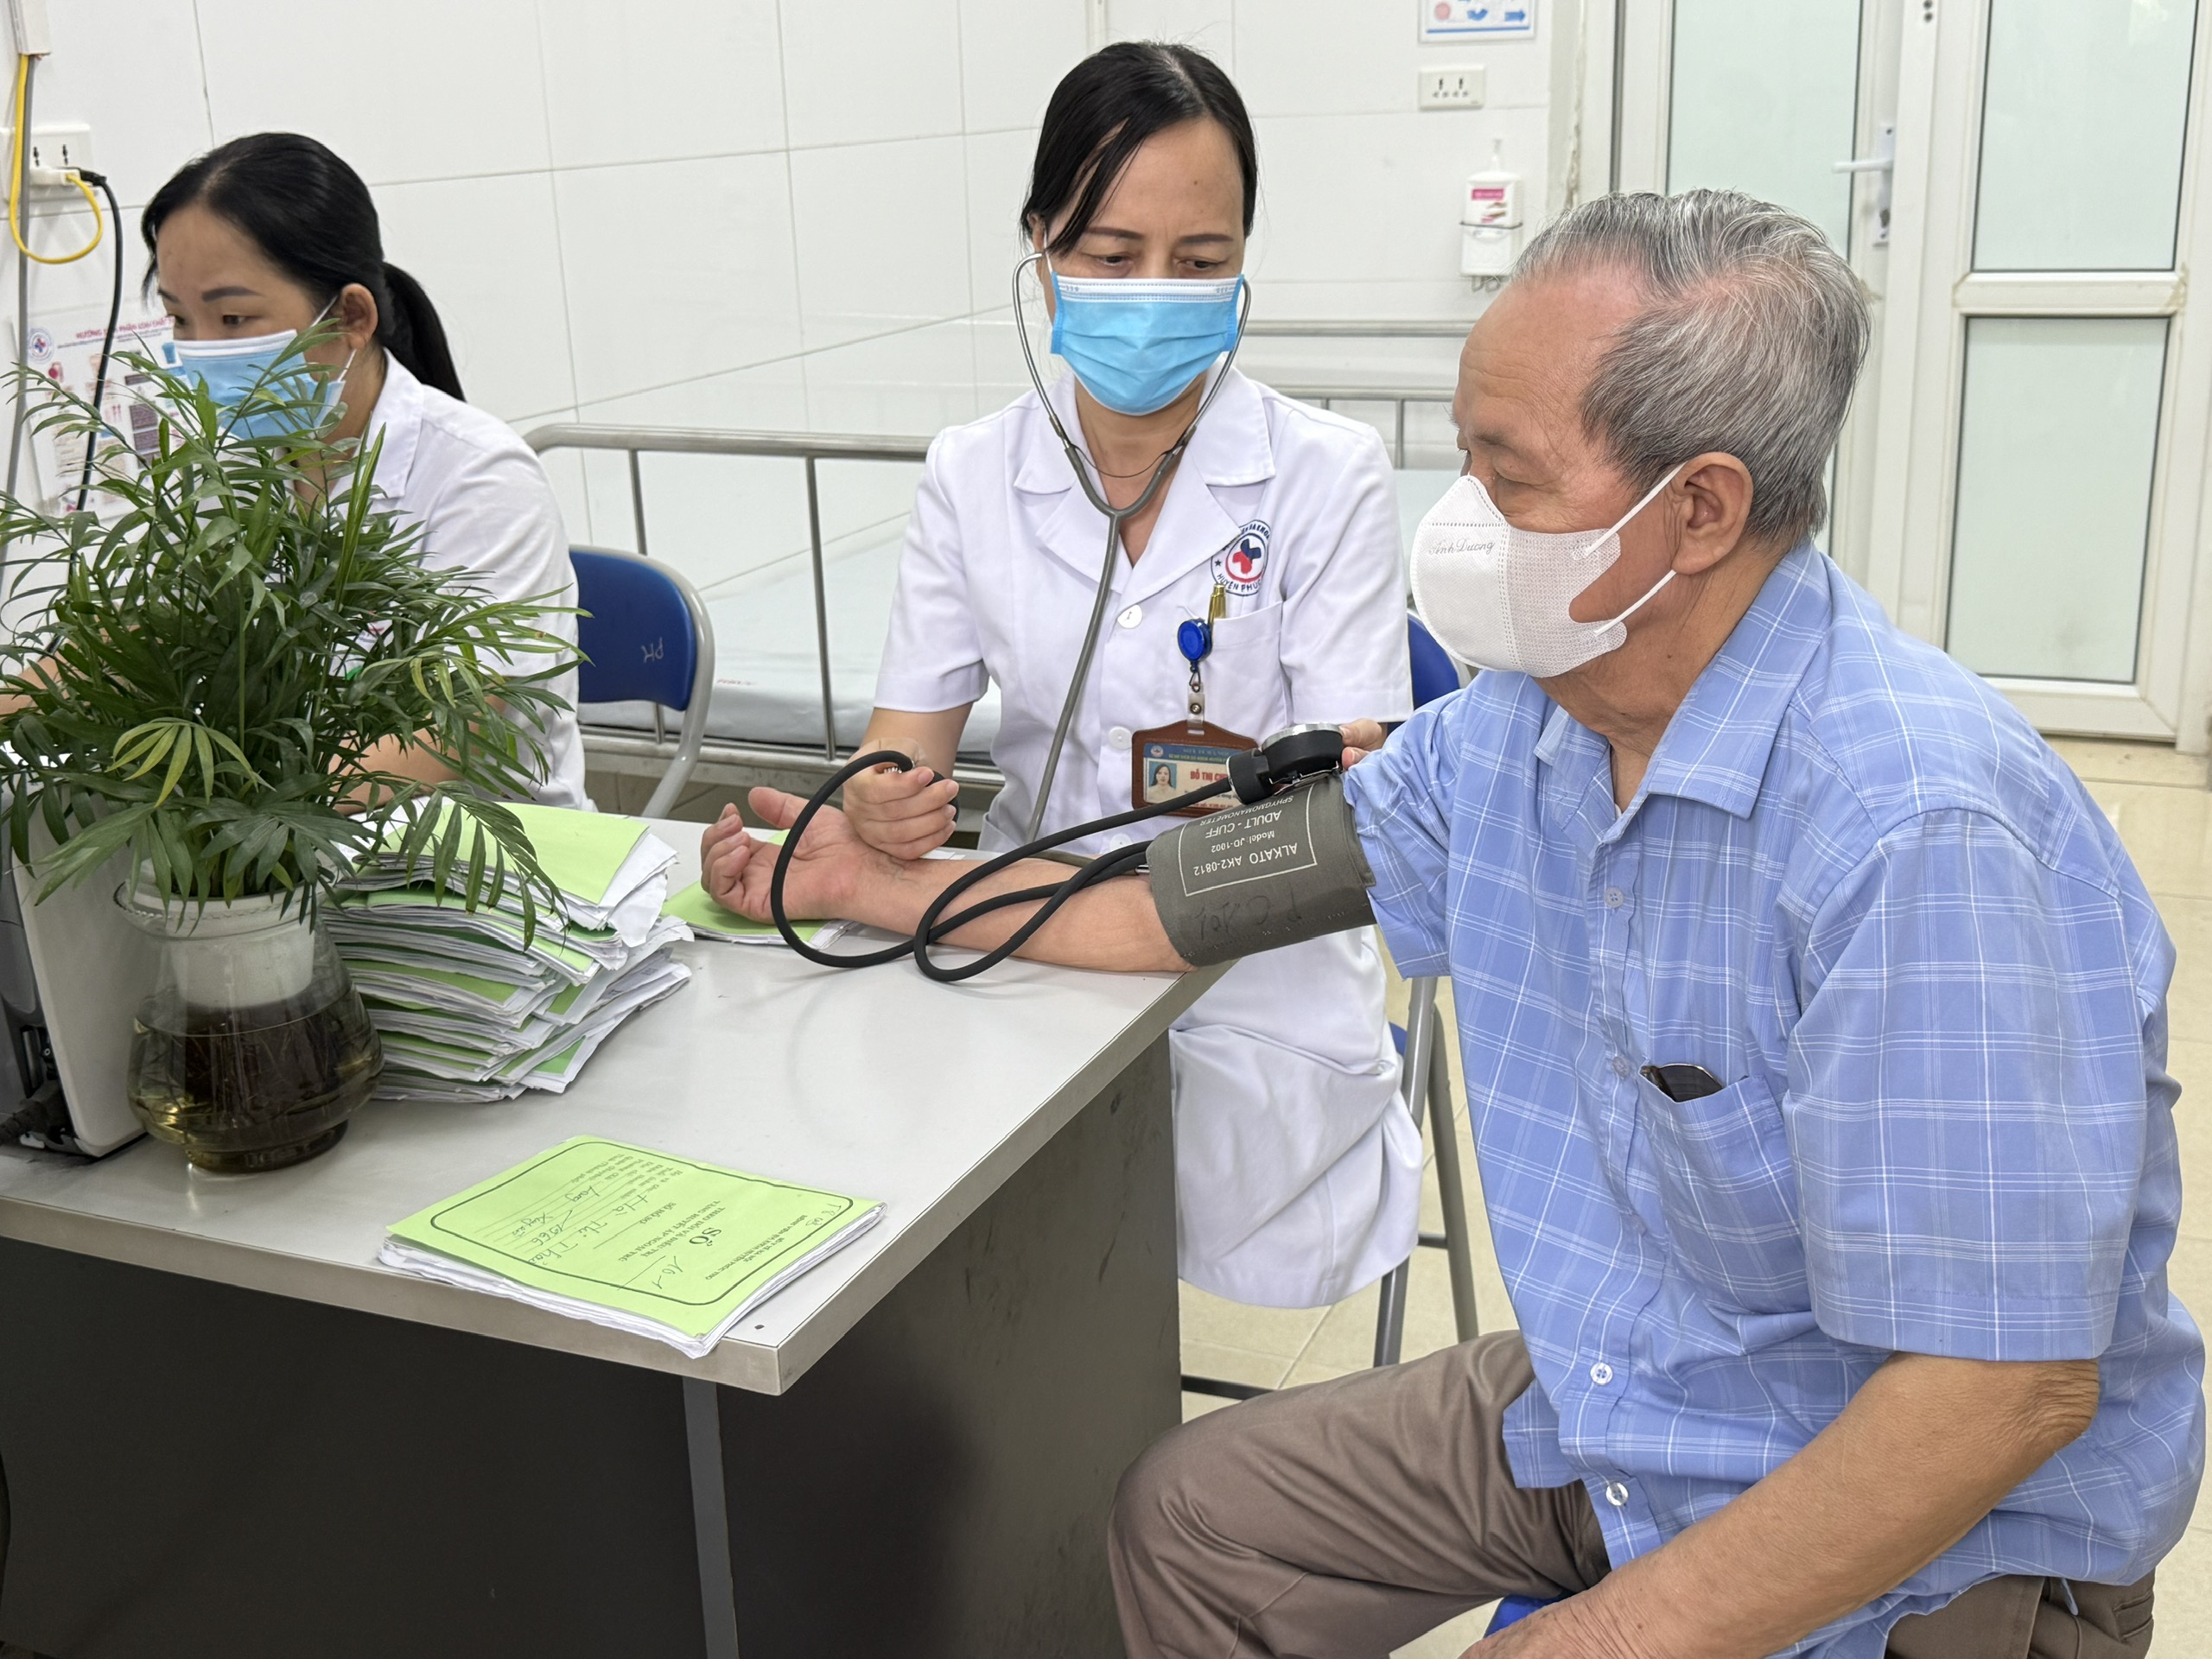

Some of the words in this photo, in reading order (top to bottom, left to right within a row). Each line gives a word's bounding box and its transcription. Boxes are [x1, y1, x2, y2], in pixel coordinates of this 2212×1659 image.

[1199, 796, 1294, 826] SPHYGMOMANOMETER
[1244, 810, 1282, 830] ADULT
[1205, 823, 1235, 839] CUFF
[1249, 842, 1298, 864] ALKATO
[1193, 855, 1243, 876] AK2-0812
[689, 1227, 721, 1246] SỔ
